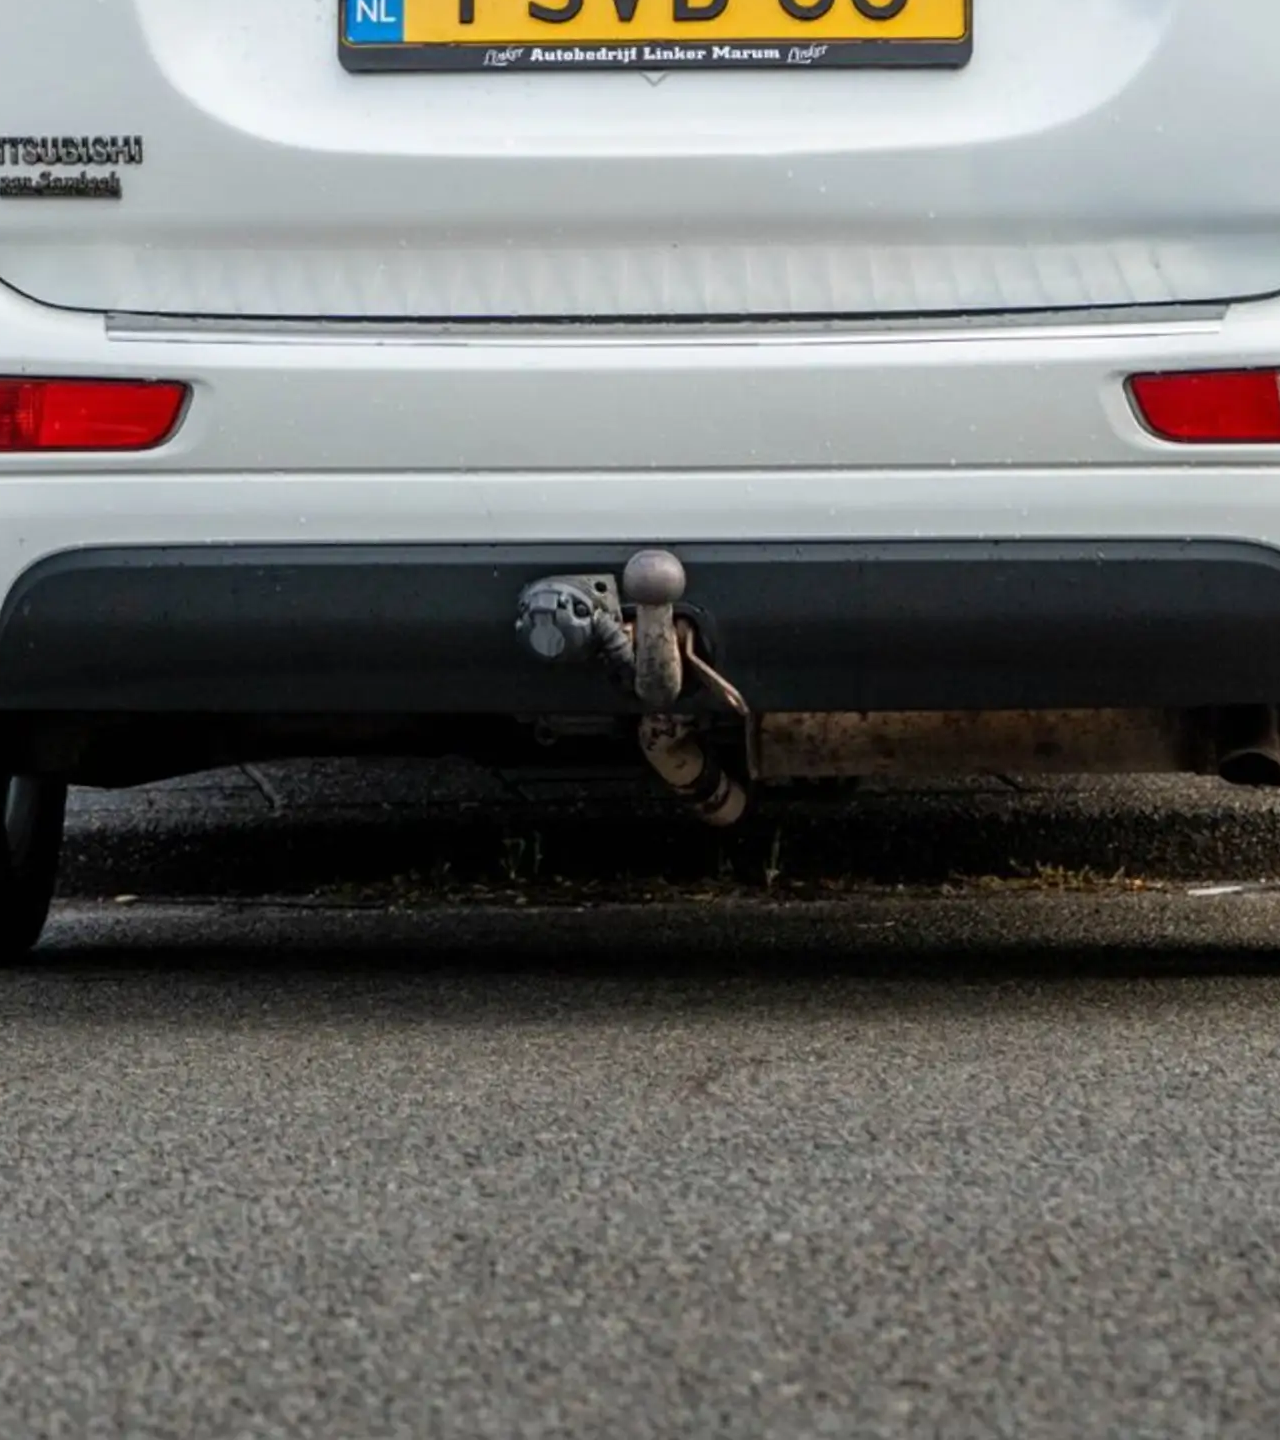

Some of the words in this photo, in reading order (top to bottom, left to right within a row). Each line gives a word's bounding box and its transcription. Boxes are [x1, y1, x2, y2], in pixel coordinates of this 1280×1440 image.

[530, 46, 638, 64] Autobedrijf
[643, 46, 707, 62] Linker
[711, 45, 781, 61] Marum
